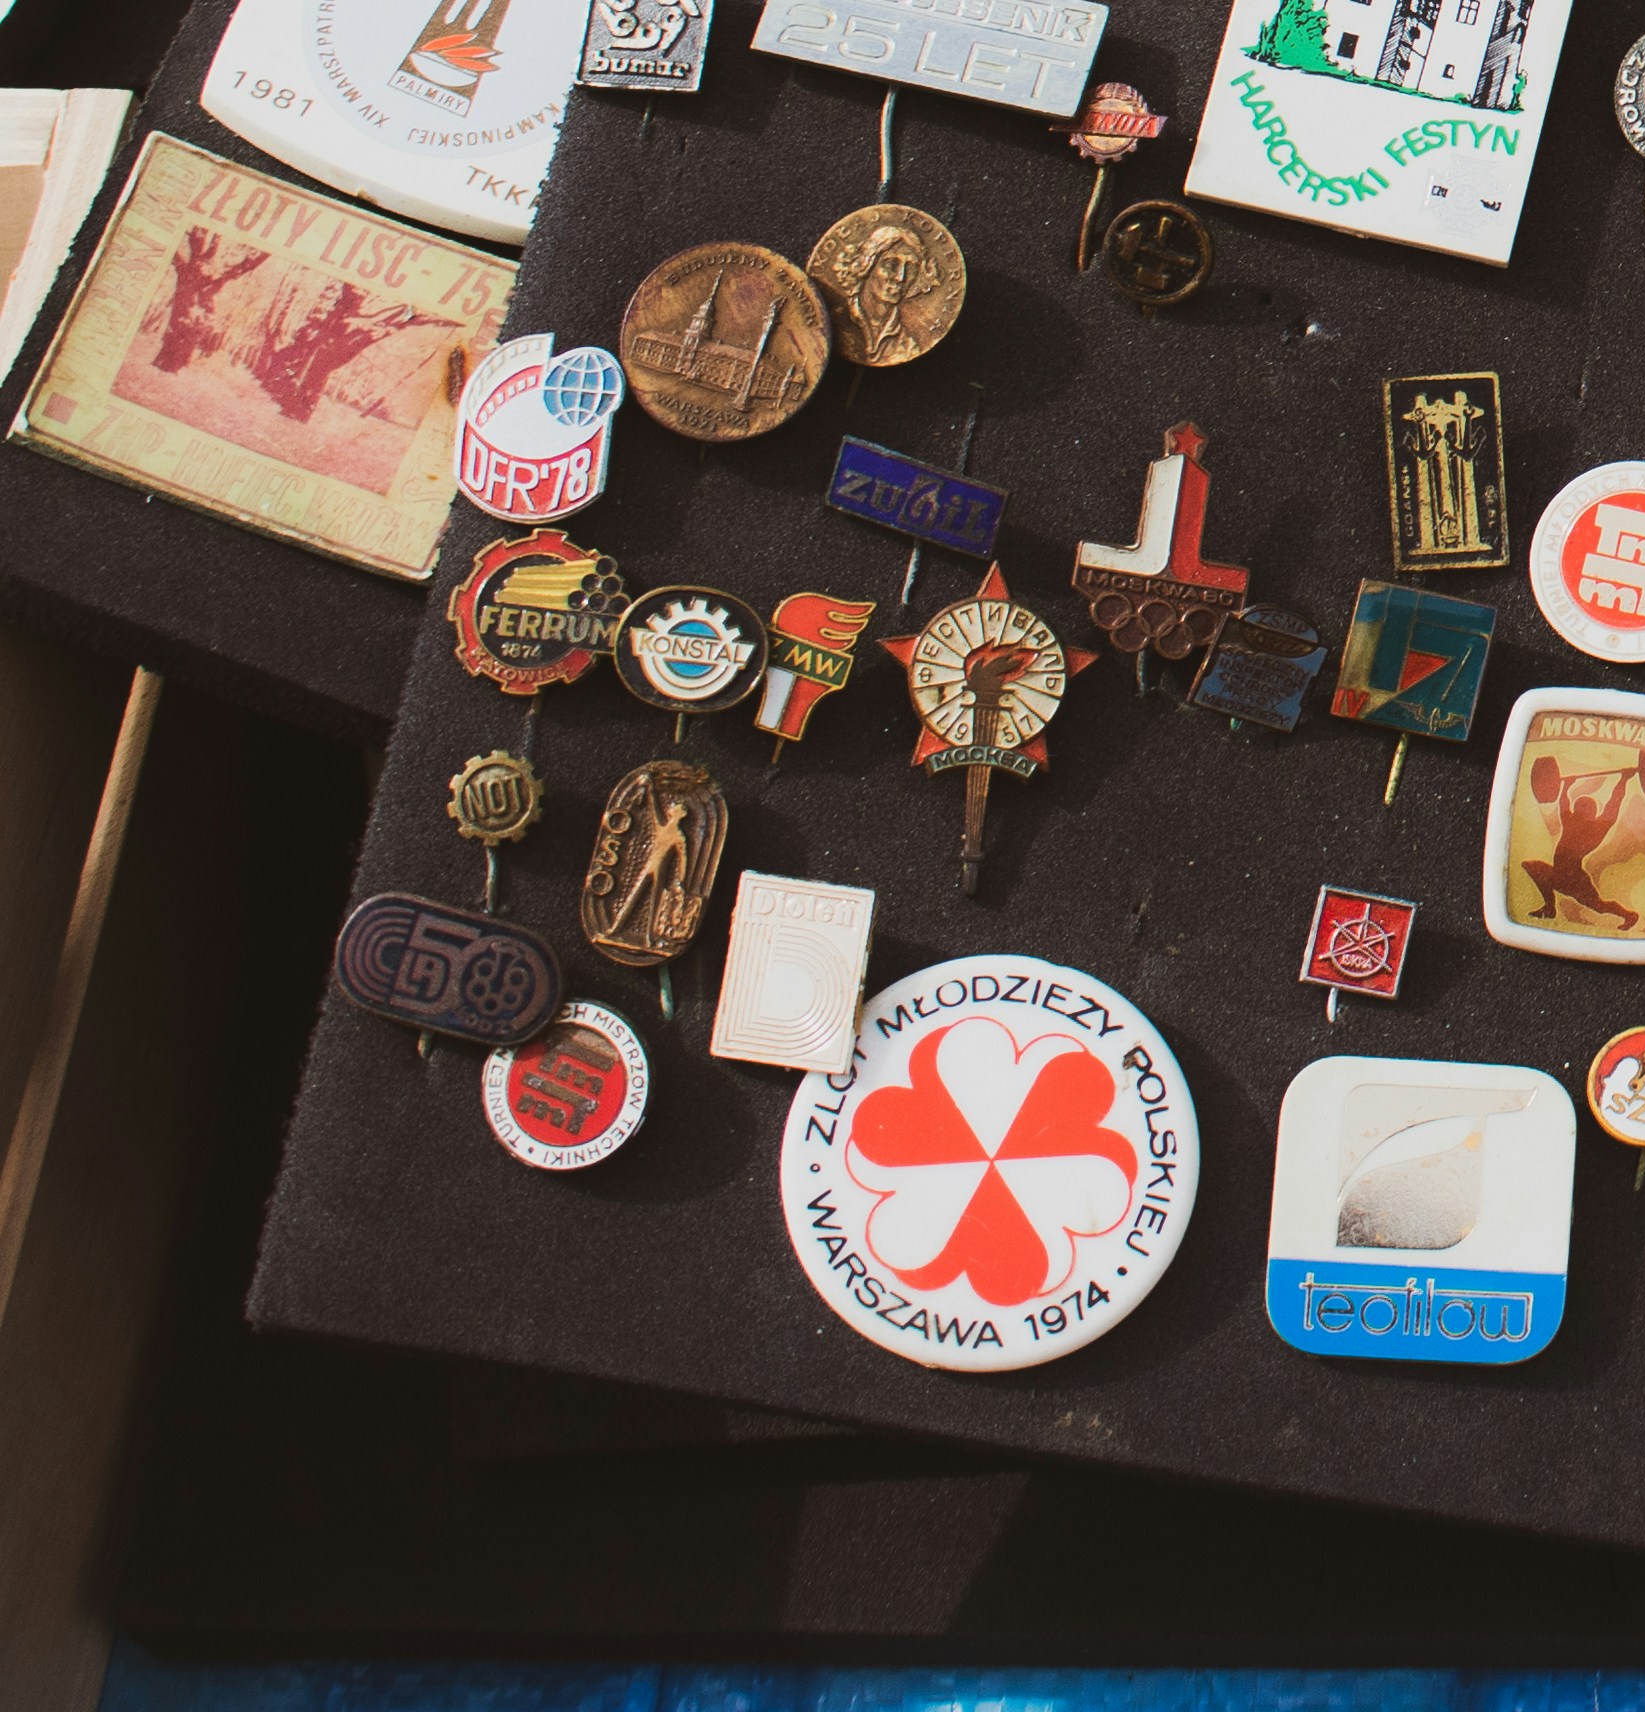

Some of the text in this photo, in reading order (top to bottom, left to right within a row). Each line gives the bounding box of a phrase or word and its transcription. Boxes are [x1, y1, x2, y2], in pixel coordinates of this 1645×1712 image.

[776, 3, 1078, 100] 25 LET
[232, 69, 316, 118] 1981
[395, 74, 469, 113] PALMIRY
[1230, 69, 1520, 208] HARCERSKI FESTYN
[465, 438, 594, 516] DFR'78
[479, 605, 619, 646] FERRUM
[640, 629, 749, 663] KONSTAL
[933, 747, 1036, 774] МОСКВА
[464, 775, 525, 822] NOT
[875, 974, 1126, 1040] MŁODZIEŻY
[1123, 1044, 1180, 1259] POLSKIEJ
[805, 1189, 1112, 1349] WARSZAWA 1974
